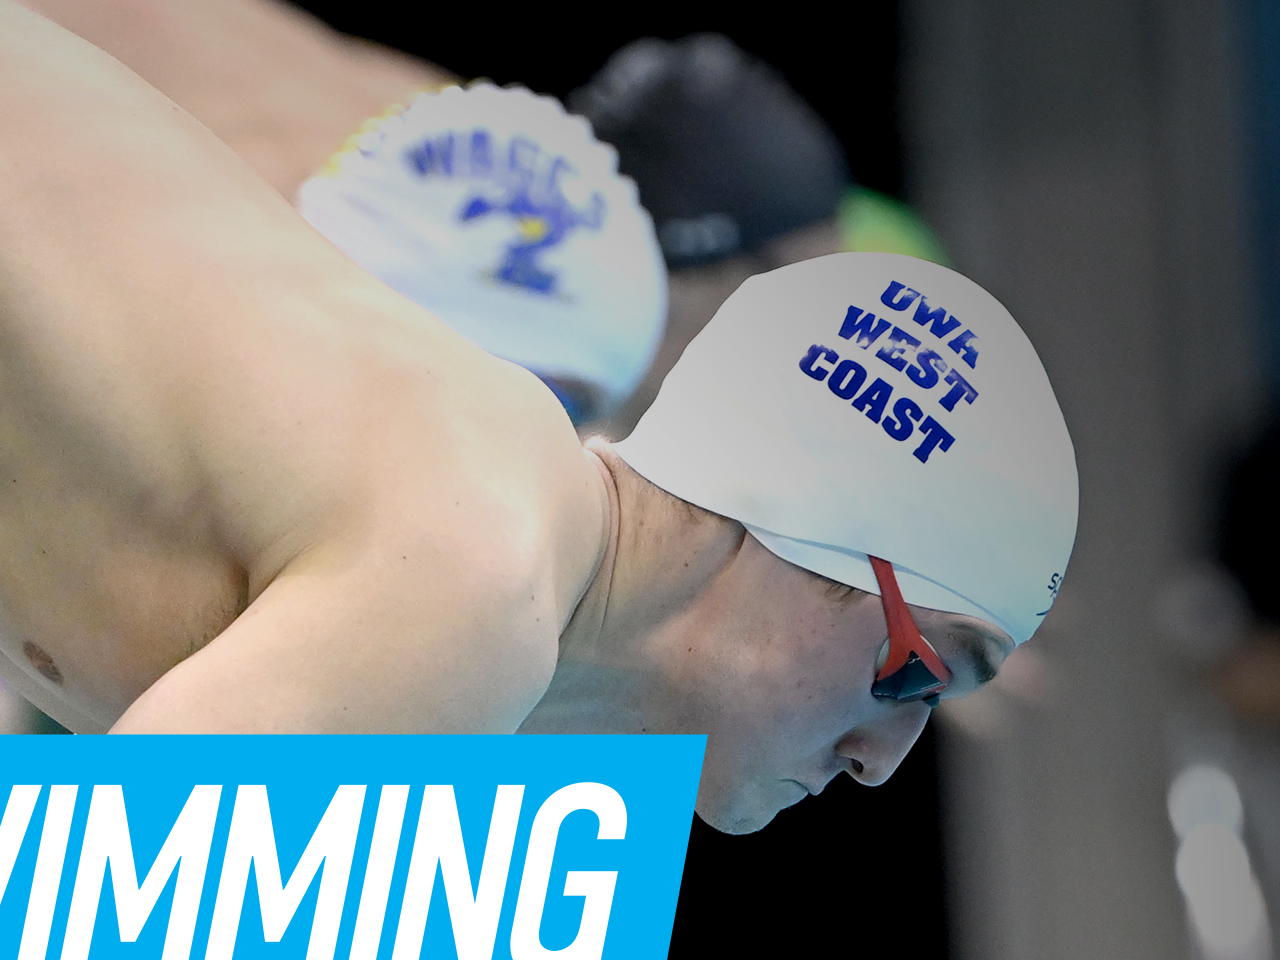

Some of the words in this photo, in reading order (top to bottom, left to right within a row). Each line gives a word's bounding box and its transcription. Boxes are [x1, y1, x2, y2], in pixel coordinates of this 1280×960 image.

[838, 304, 980, 413] WEST
[880, 280, 980, 370] UWA
[798, 343, 956, 464] COAST
